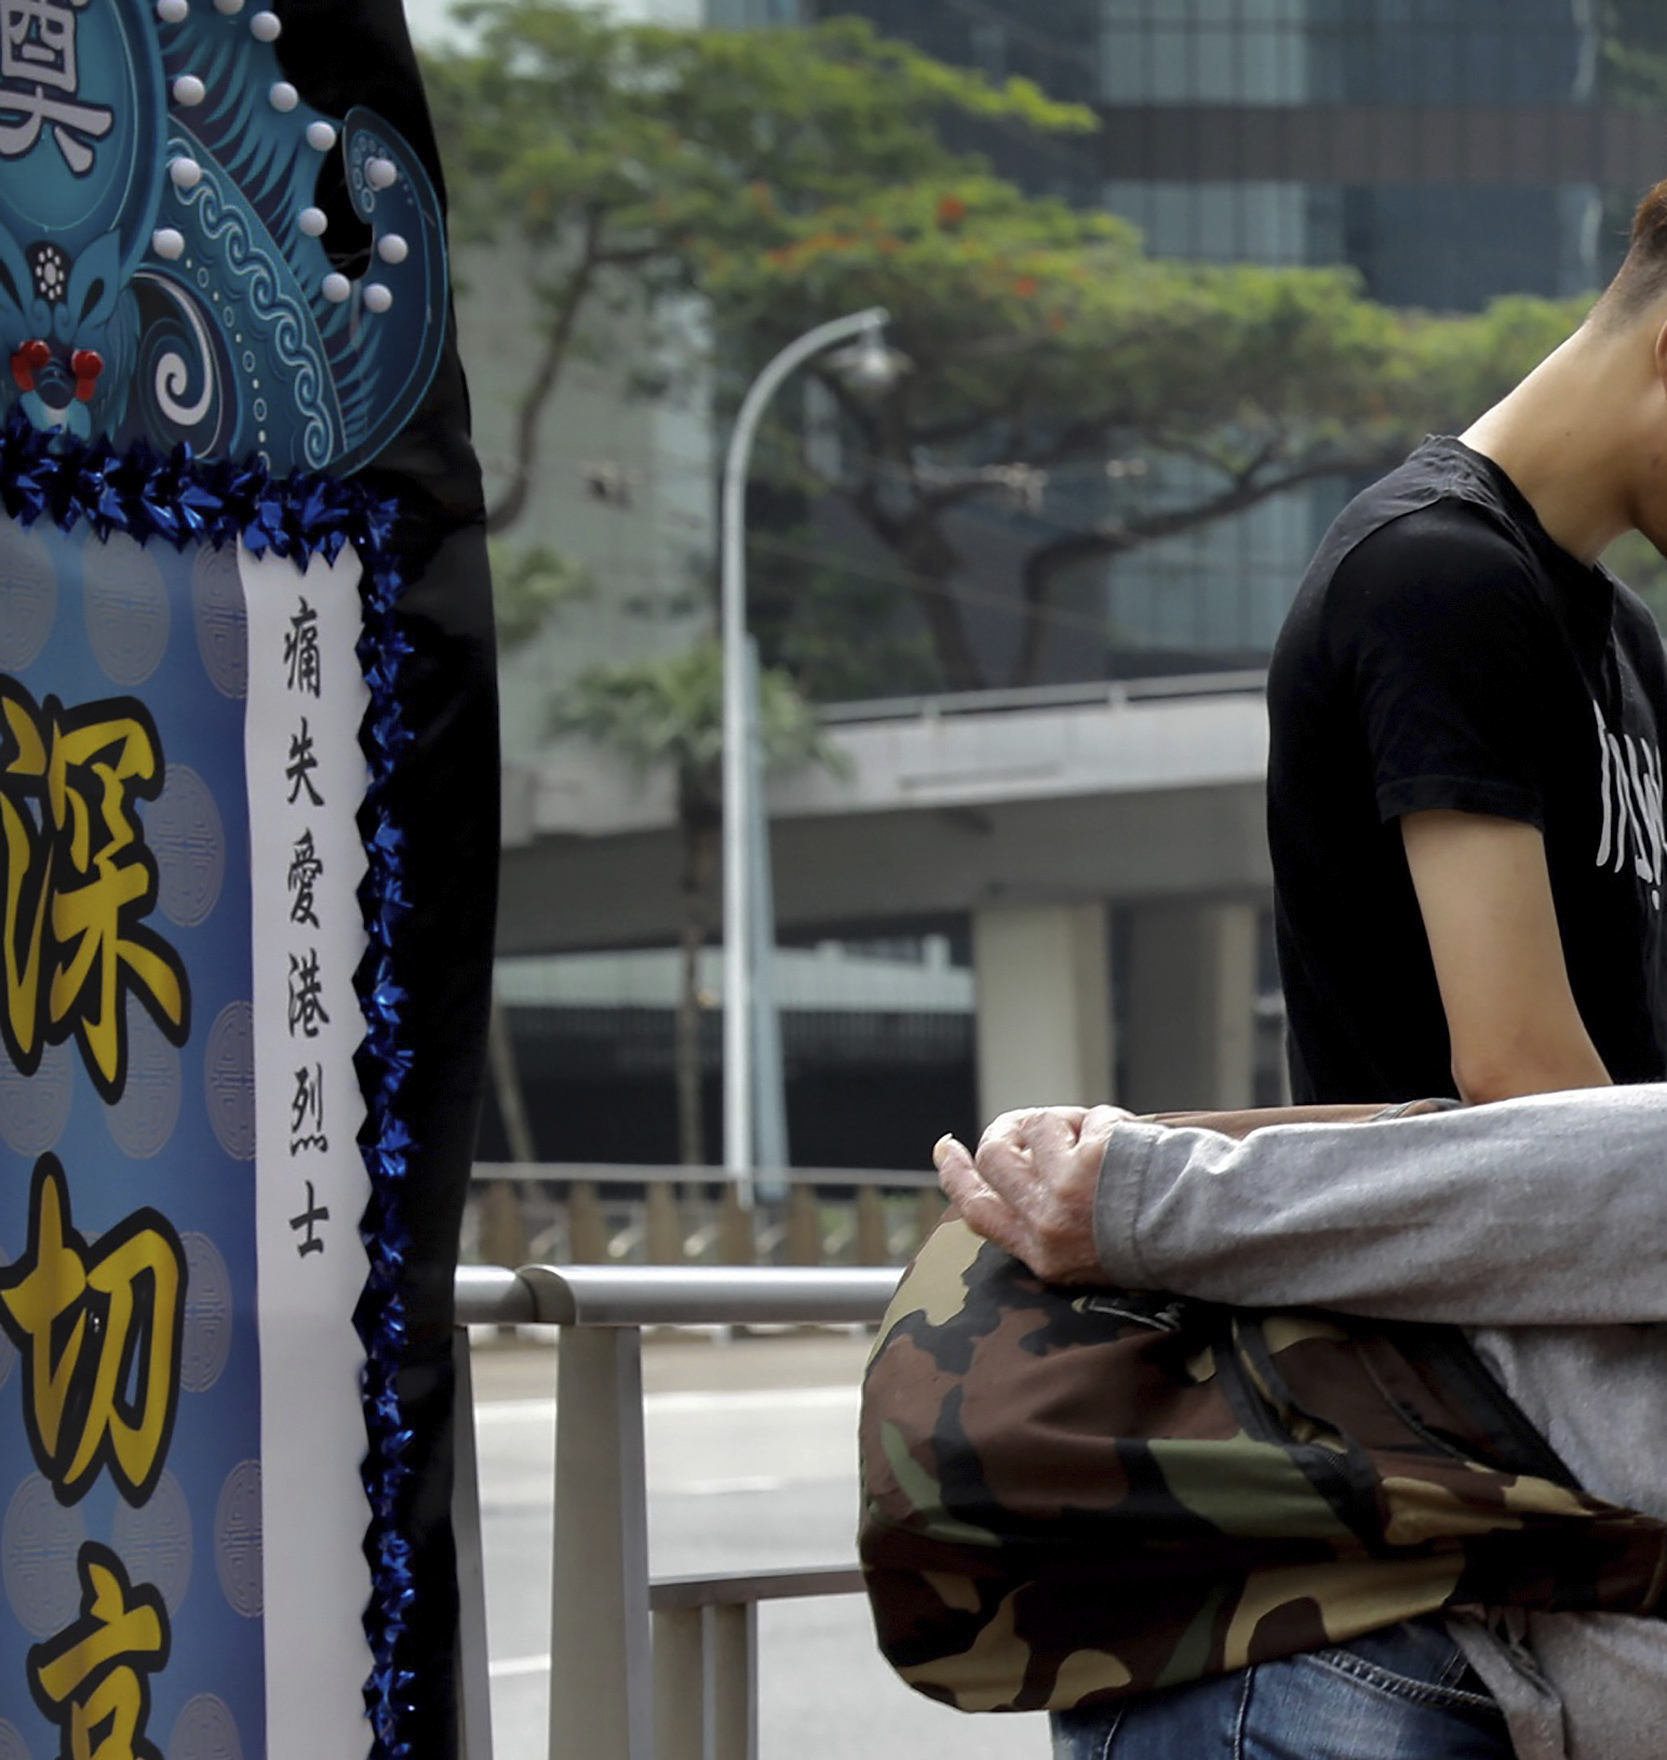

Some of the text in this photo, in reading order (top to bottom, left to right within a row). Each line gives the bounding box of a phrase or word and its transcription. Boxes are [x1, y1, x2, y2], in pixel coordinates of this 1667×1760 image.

[282, 596, 332, 1259] 痛失愛港烈士
